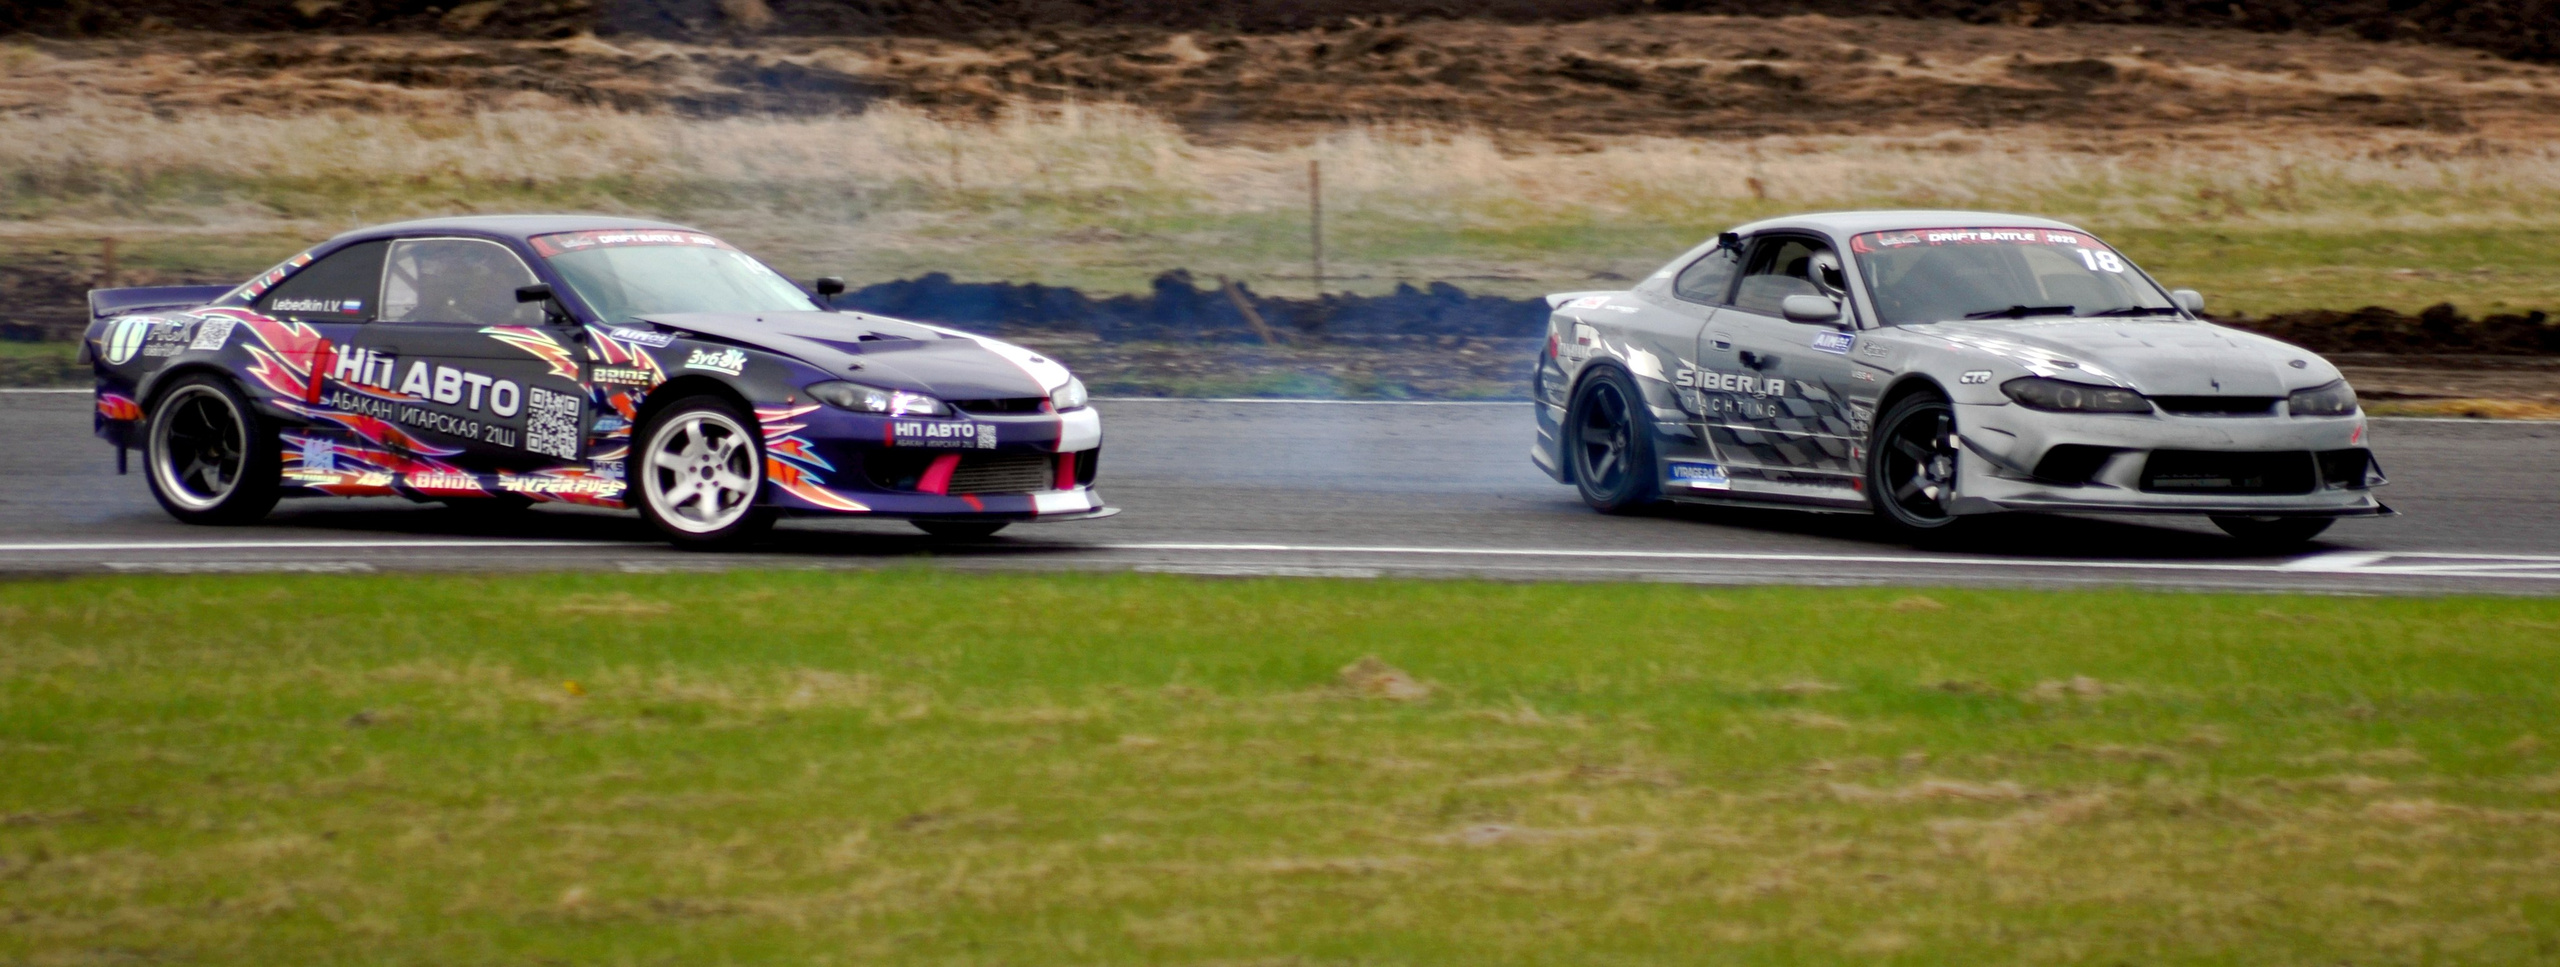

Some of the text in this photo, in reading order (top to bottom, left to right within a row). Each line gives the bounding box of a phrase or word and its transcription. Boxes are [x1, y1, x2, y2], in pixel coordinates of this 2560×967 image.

[598, 234, 636, 244] DRIFT
[638, 234, 684, 243] BATTLE
[1928, 232, 1978, 242] DRIFT
[1980, 232, 2036, 241] BATTLE
[2076, 248, 2124, 273] 18
[272, 299, 341, 312] Lebedkin I.V.
[334, 344, 521, 417] НП АВТО
[593, 368, 651, 386] BRIDE
[1686, 396, 1777, 418] YACHTING
[330, 391, 516, 448] АБАКАН ИГАРСКАЯ 21Ш
[895, 422, 975, 438] НП АВТО
[594, 460, 624, 472] HKS
[415, 471, 483, 490] BRIDE
